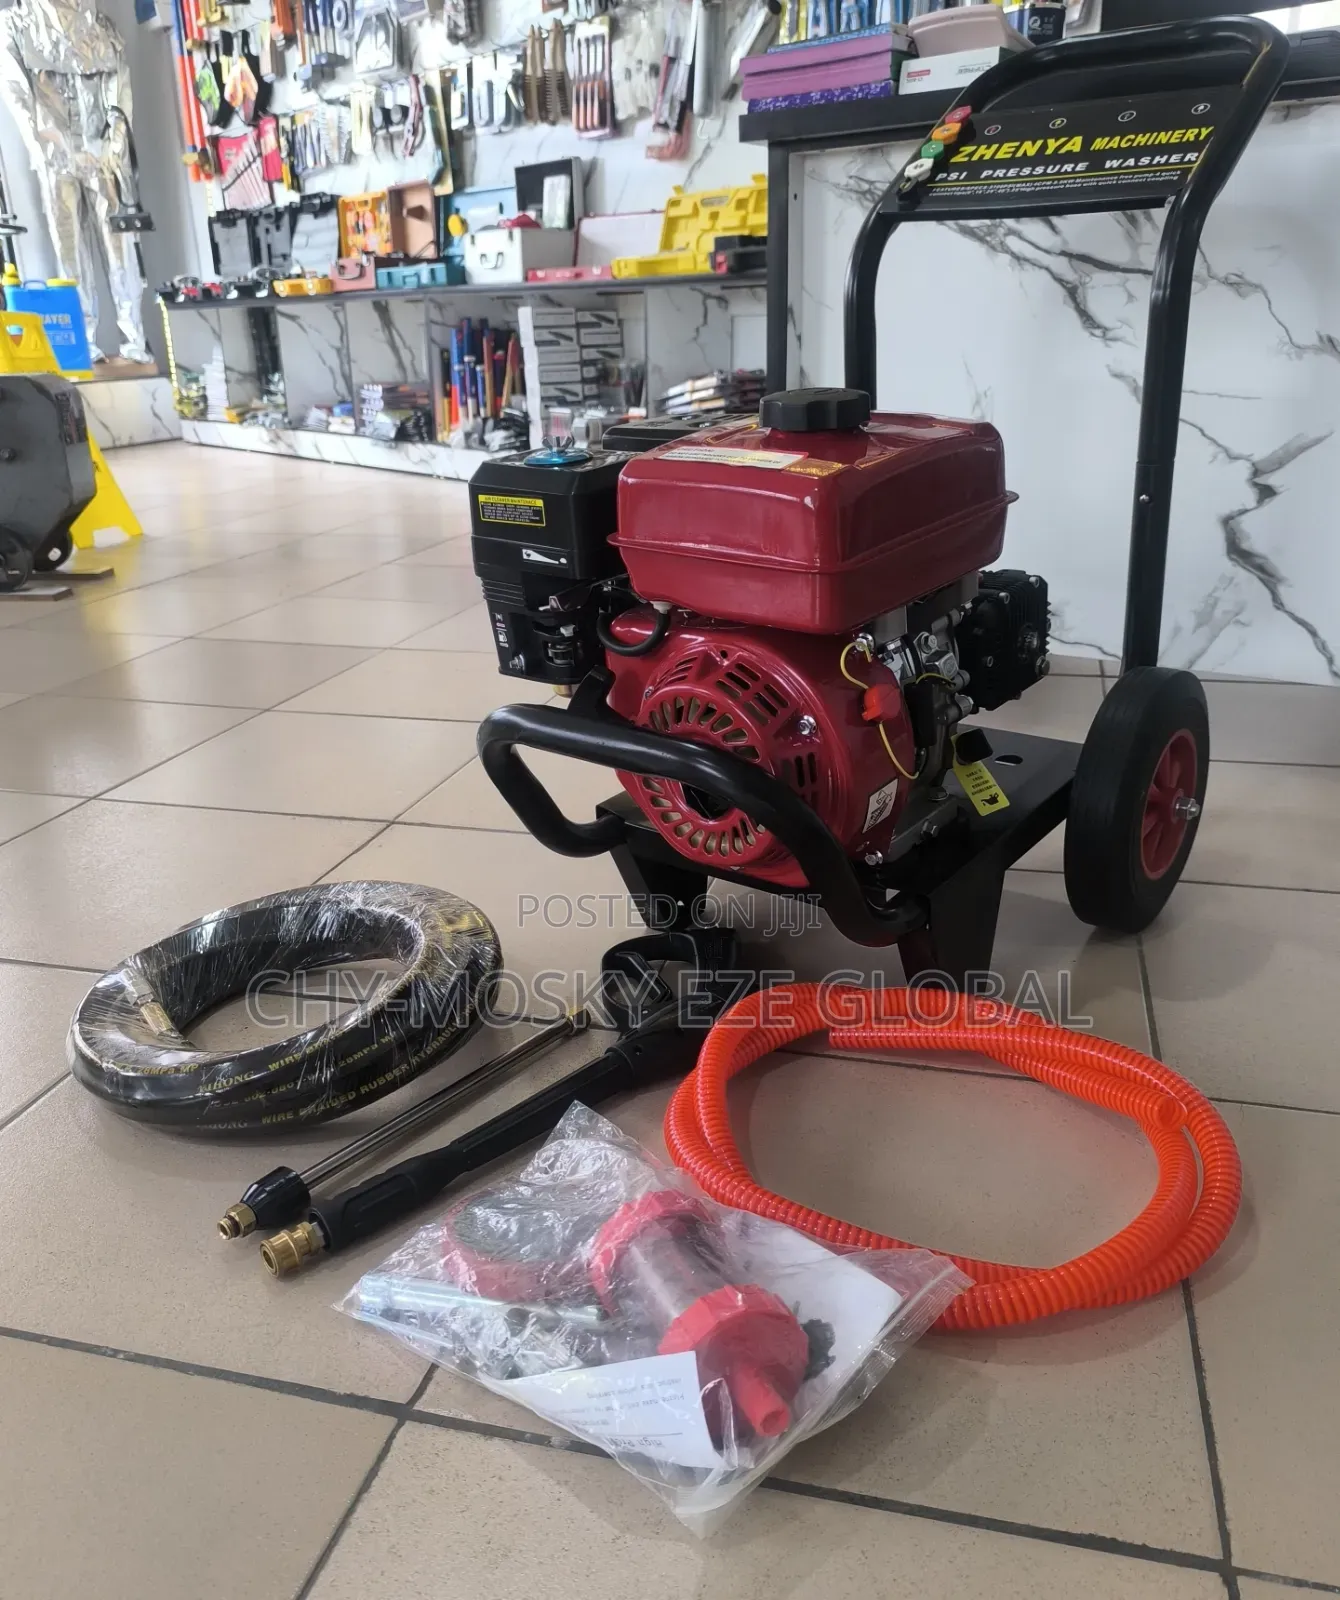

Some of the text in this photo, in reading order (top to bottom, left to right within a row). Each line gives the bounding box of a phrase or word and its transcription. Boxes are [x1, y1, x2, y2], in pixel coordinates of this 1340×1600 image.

[950, 126, 1214, 162] ZHENYA MACHINERY
[935, 152, 1199, 181] PSI PRESSURE WASHER
[261, 1110, 294, 1124] WIRE
[360, 1063, 410, 1094] RUBBER
